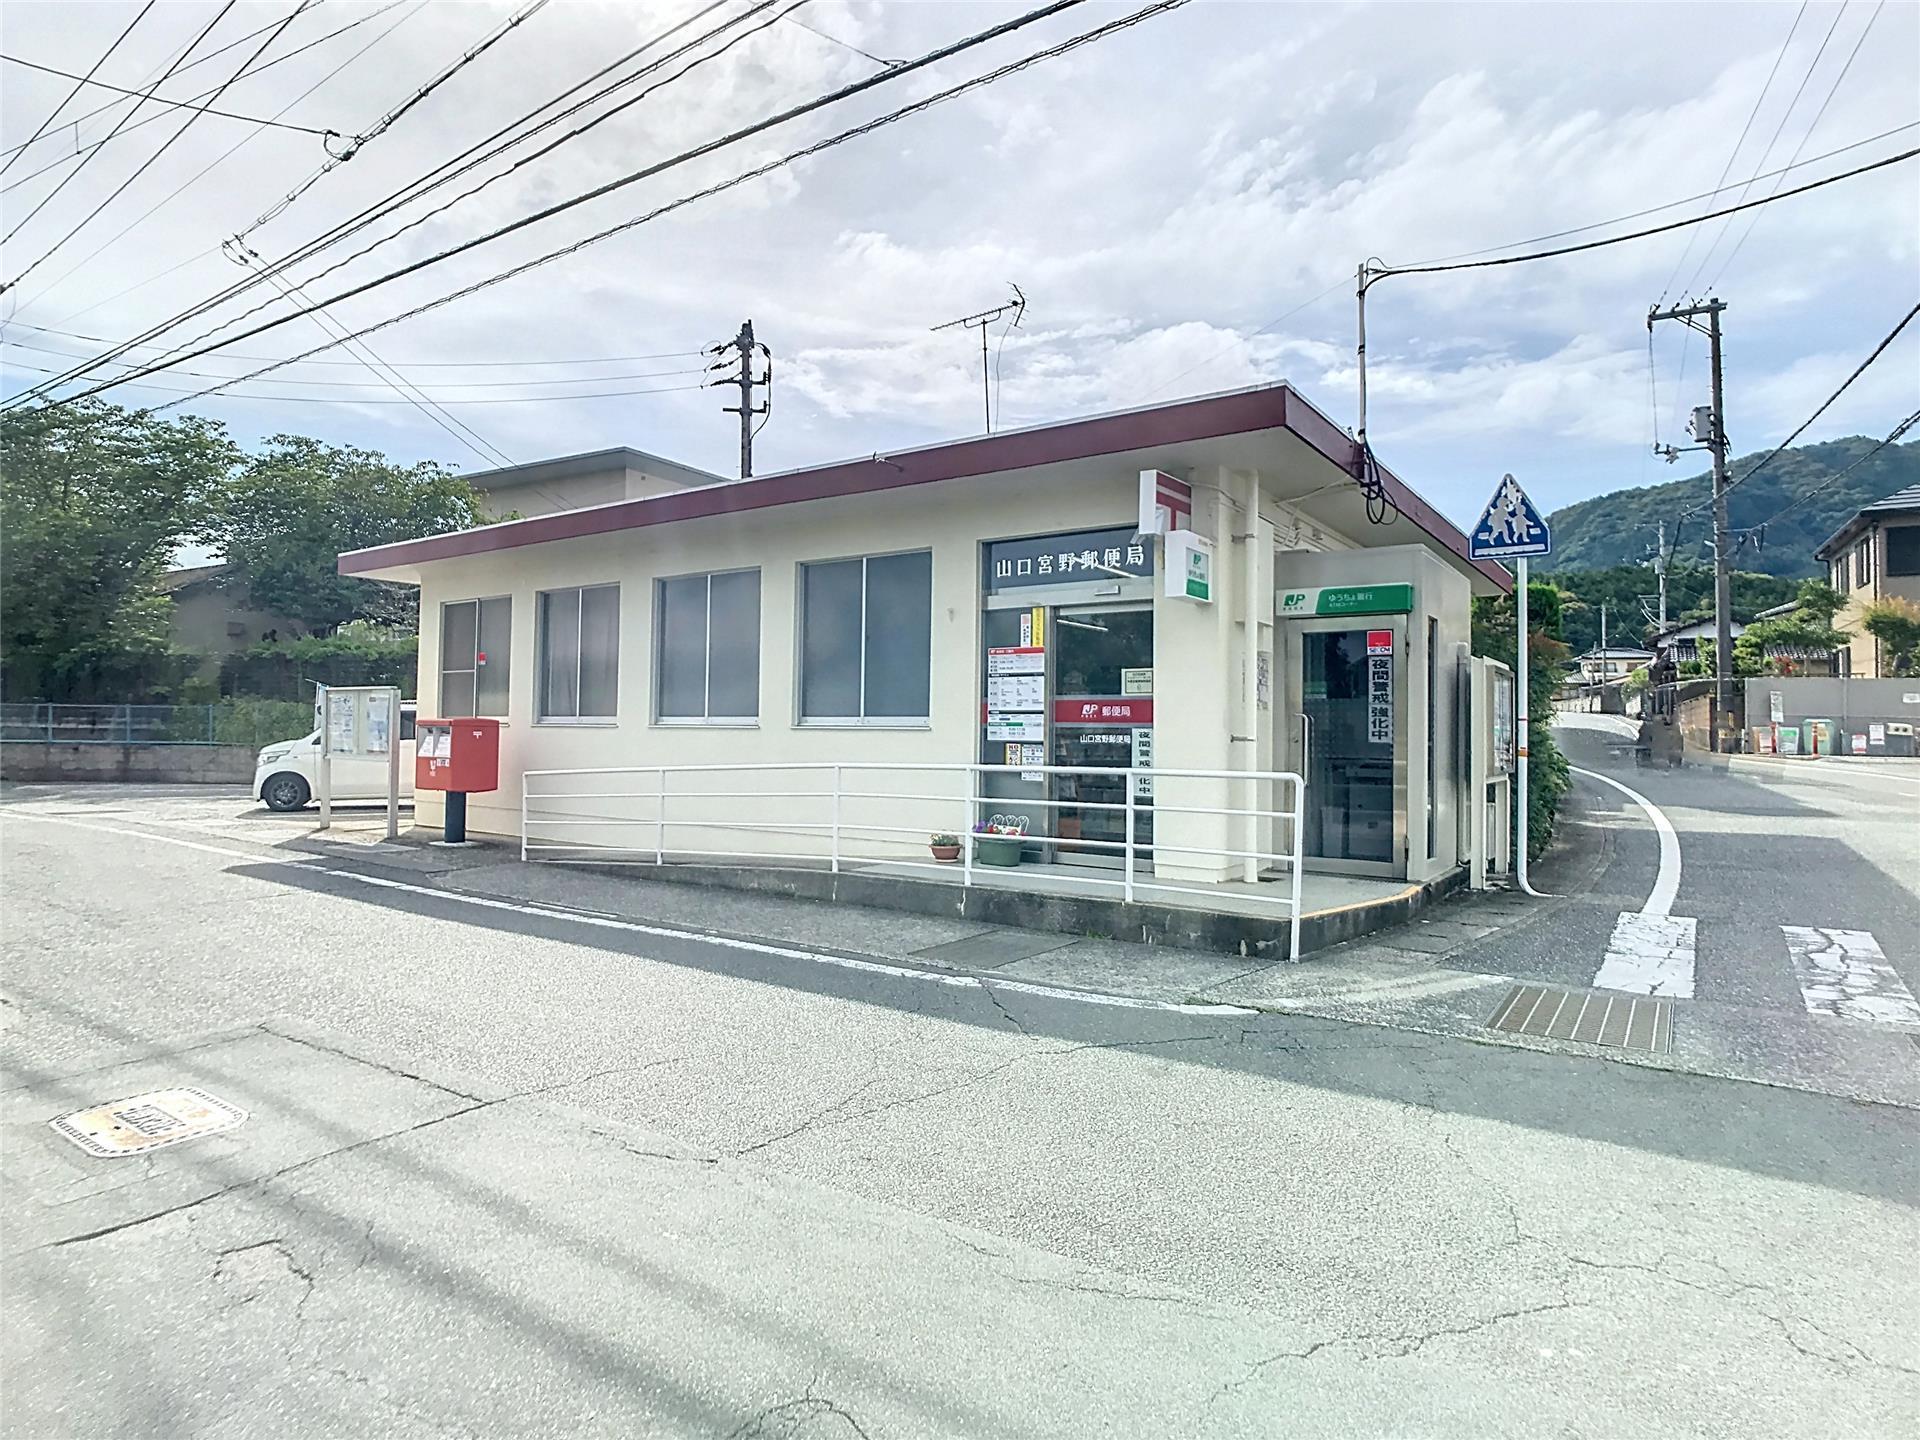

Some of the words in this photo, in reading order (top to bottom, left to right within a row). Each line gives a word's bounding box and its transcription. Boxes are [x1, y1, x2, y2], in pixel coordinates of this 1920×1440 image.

[996, 545, 1144, 578] 山口宮野郵便局
[1328, 592, 1373, 602] ゆうちょ銀行
[1102, 705, 1131, 717] 郵便局
[1371, 658, 1390, 741] 夜間警戒強化中
[1138, 731, 1151, 794] 夜間警戒化中
